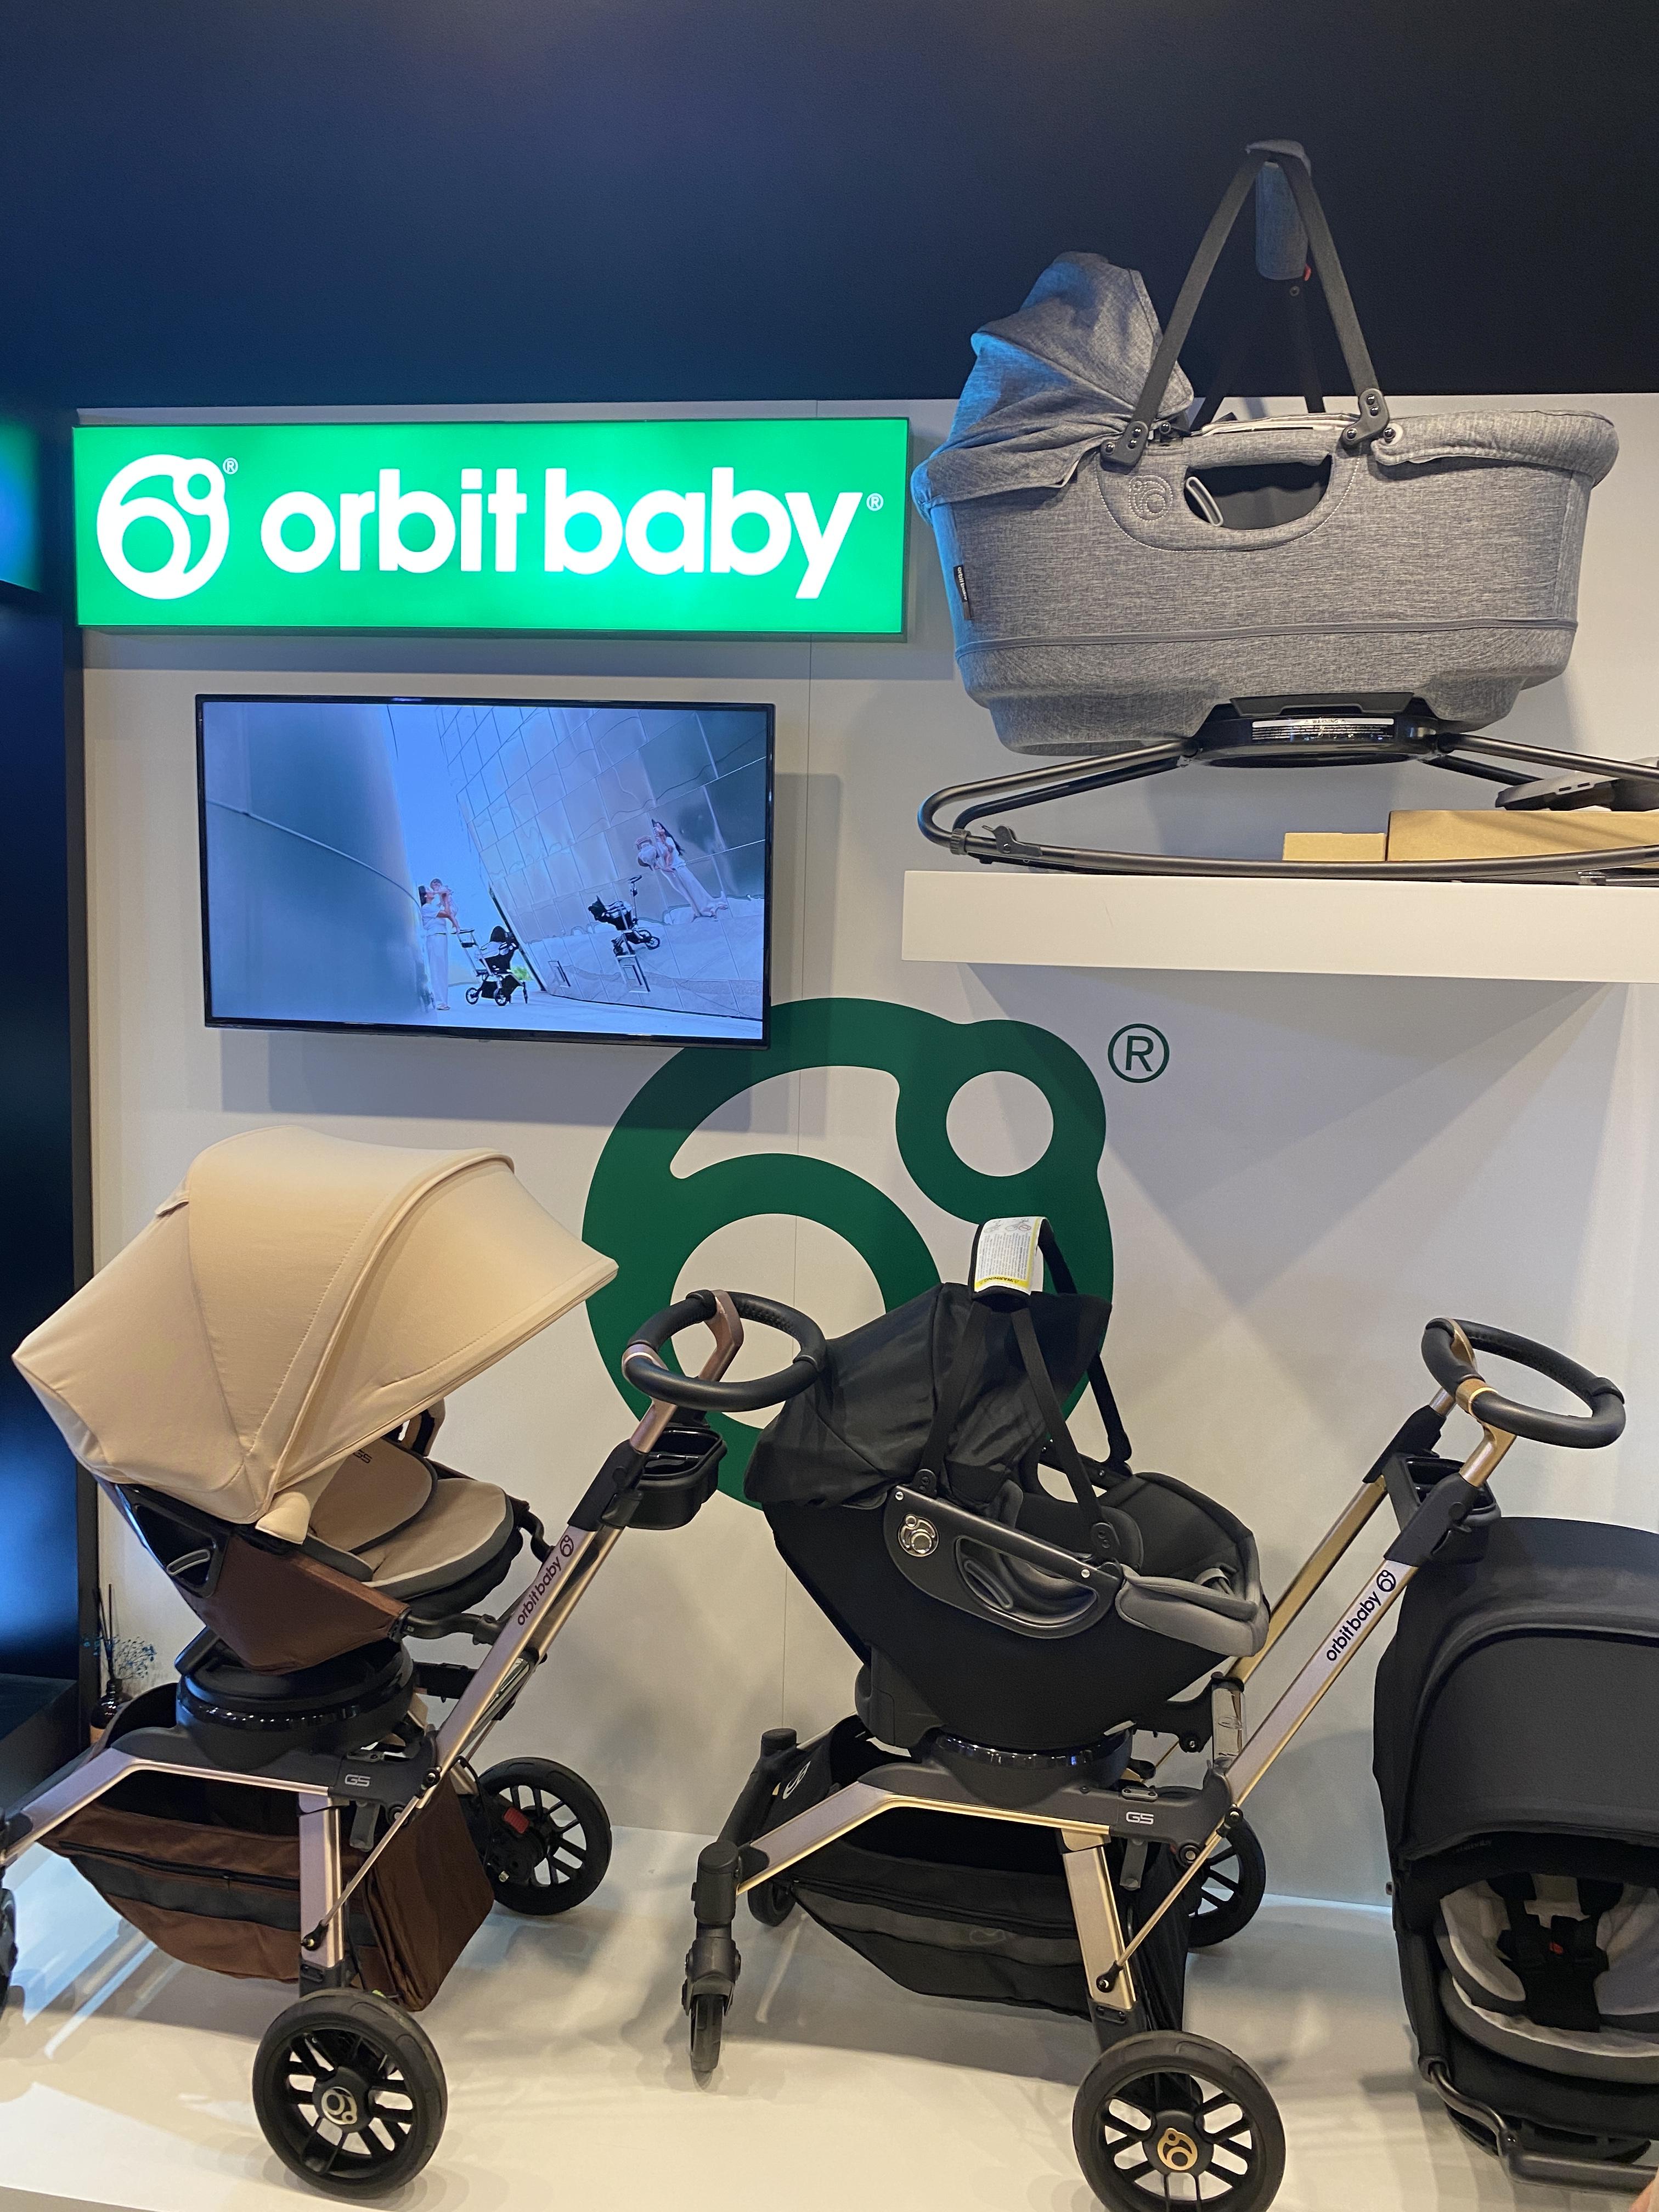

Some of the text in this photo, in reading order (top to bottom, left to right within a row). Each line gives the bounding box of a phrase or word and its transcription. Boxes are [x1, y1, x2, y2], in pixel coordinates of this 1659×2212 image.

[260, 468, 506, 574] orbit
[517, 1556, 561, 1626] orbit baby
[1327, 1591, 1381, 1661] orbit baby
